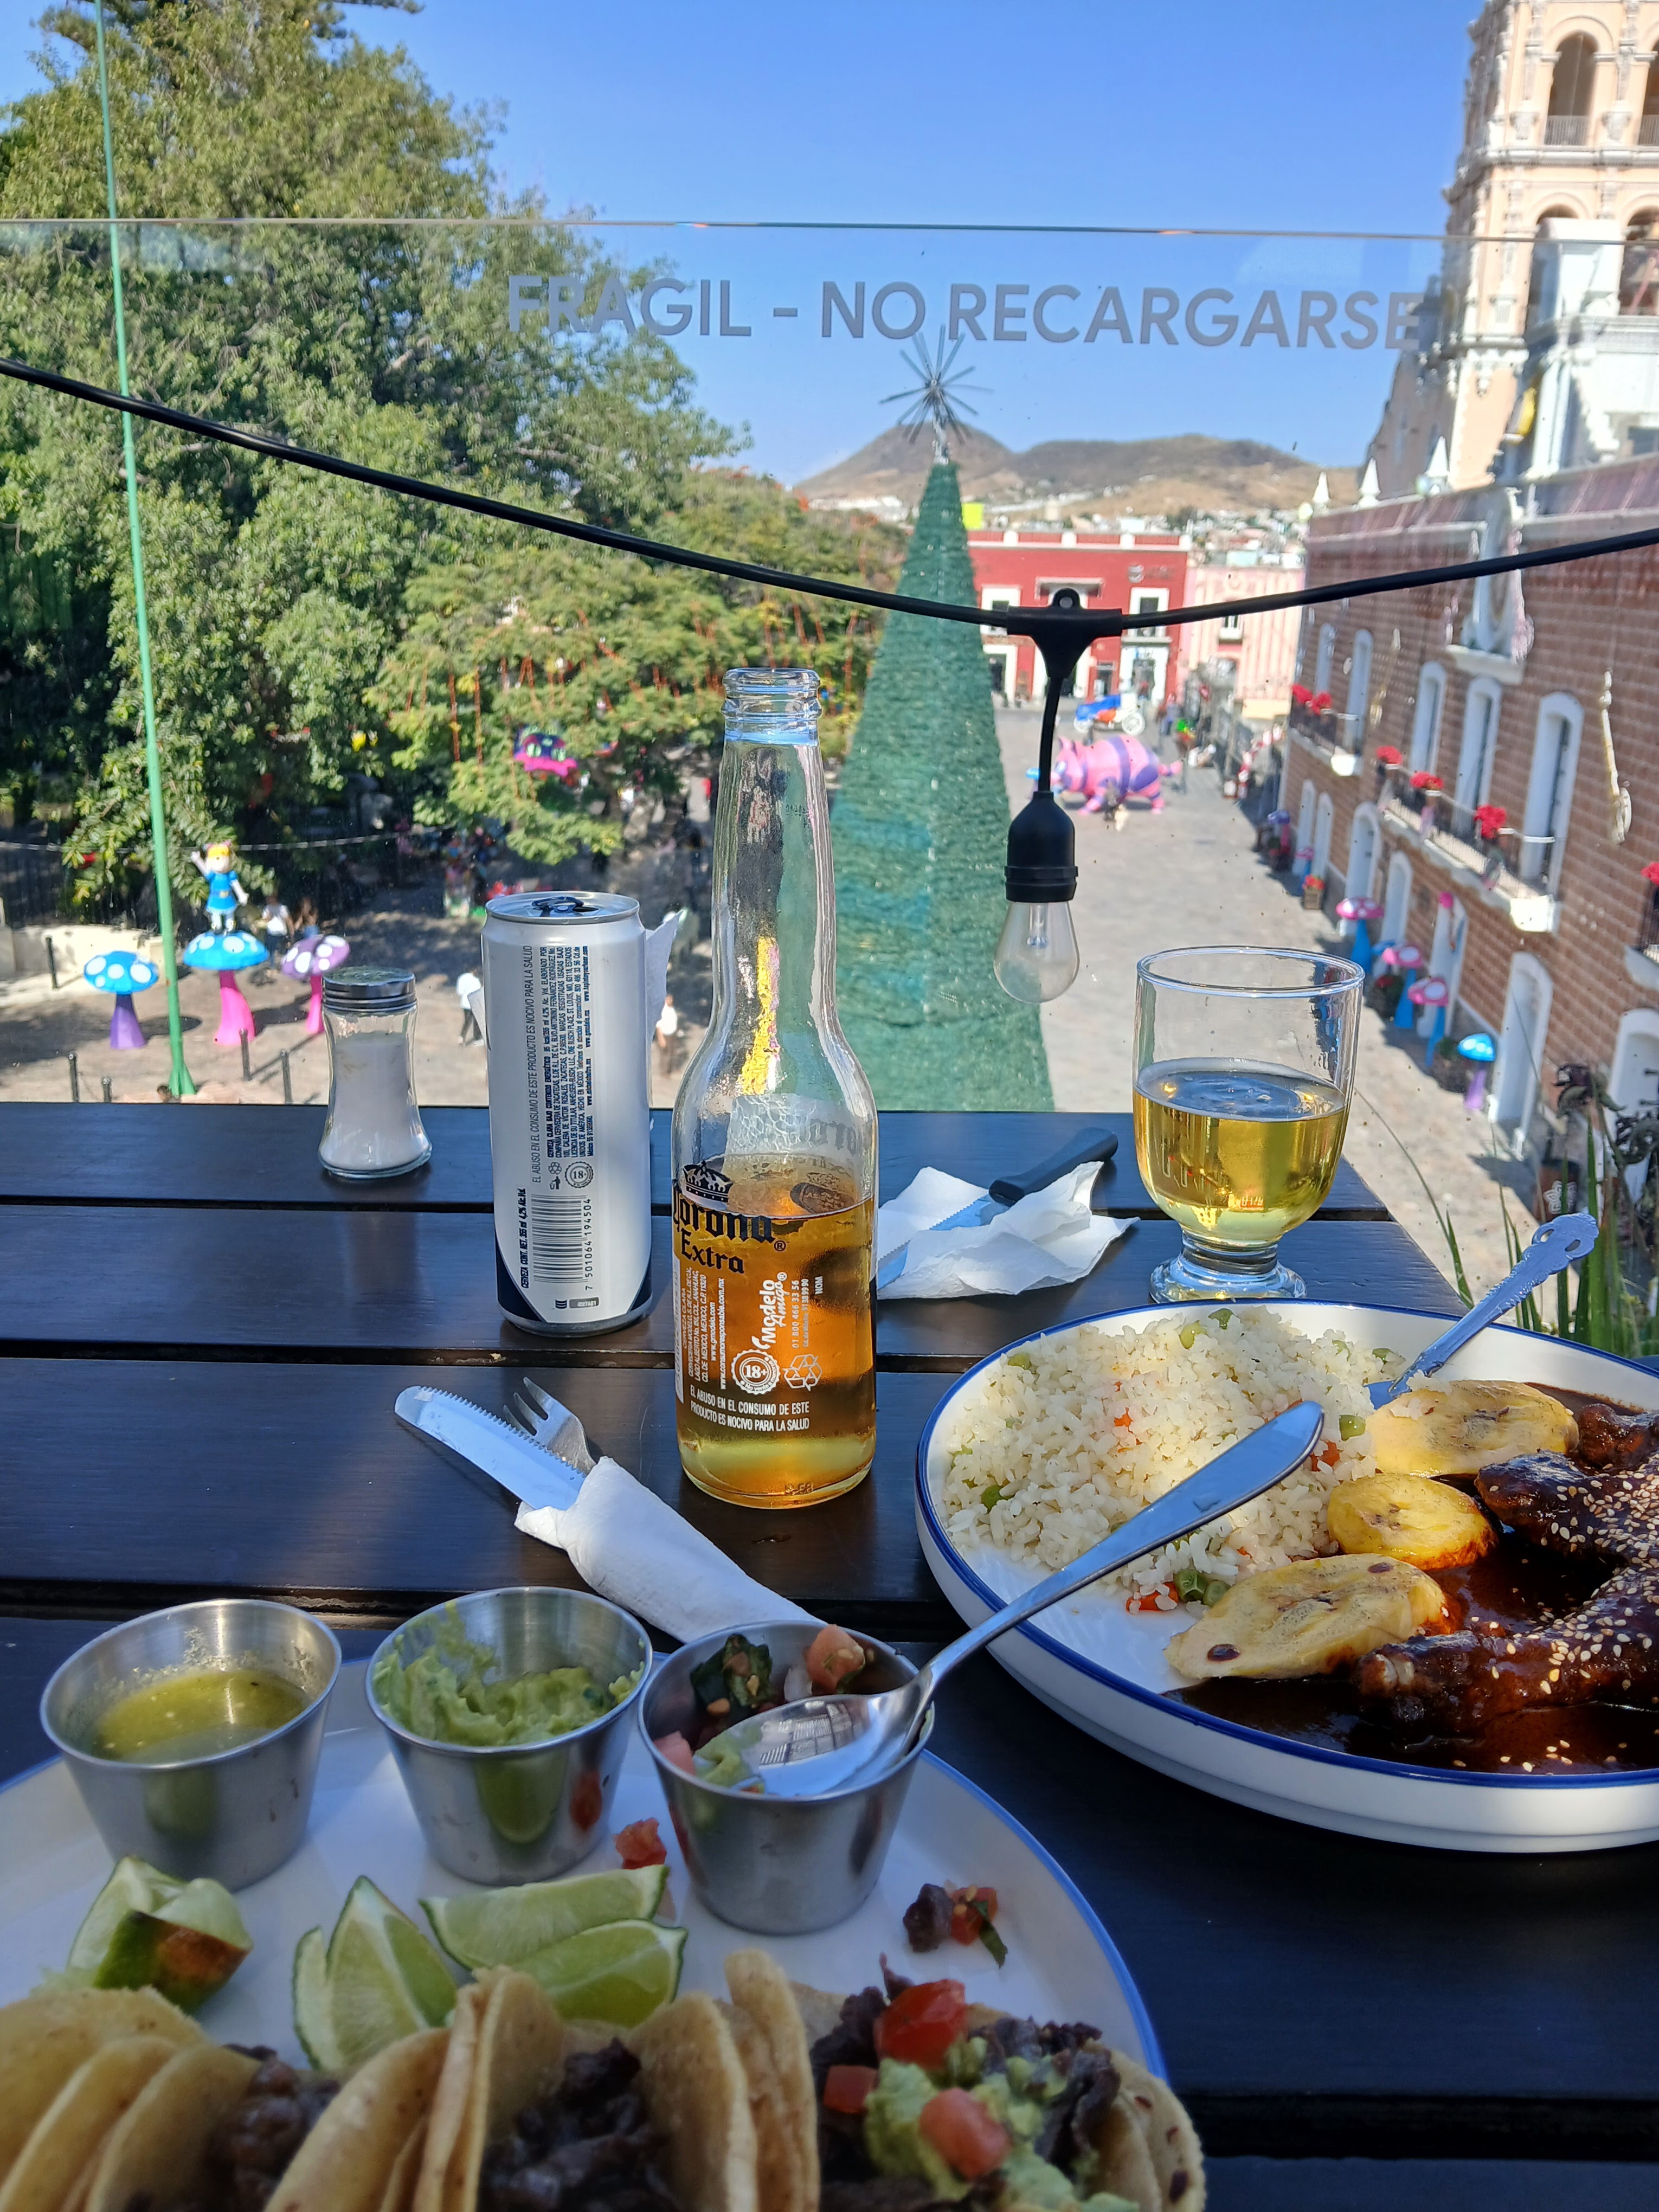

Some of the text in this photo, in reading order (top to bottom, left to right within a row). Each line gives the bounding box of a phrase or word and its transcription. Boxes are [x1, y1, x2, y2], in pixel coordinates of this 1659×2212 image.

[507, 274, 1425, 350] FRAGIL - NO RECARGARSE
[523, 946, 533, 968] SALUD
[524, 969, 533, 978] LA
[524, 979, 533, 997] PARA
[557, 981, 565, 1011] REGISTRADAS
[525, 999, 535, 1024] NOCIVO
[526, 1025, 535, 1033] ES
[526, 1036, 536, 1071] PRODUCTO
[528, 1072, 537, 1088] ESTE
[529, 1089, 538, 1098] DE
[529, 1099, 539, 1131] CONSUMO
[531, 1142, 539, 1151] EN
[531, 1153, 541, 1174] ABUSO
[583, 1199, 591, 1236] 194504
[519, 1239, 528, 1250] NET.
[681, 1227, 744, 1274] Extra
[520, 1251, 528, 1265] CONT.
[584, 1241, 593, 1277] 501064
[520, 1267, 529, 1289] CERVEZA
[792, 1280, 799, 1290] 56
[769, 1281, 789, 1327] Amigo
[792, 1293, 799, 1302] 33
[759, 1279, 776, 1343] Modelo
[709, 1302, 717, 1361] www.gmodelo.com
[792, 1340, 799, 1348] 01
[702, 1360, 708, 1371] DE
[744, 1365, 768, 1379] 18+
[690, 1385, 810, 1416] EL ABUSO EN EL CONSUMO DE ESTE
[691, 1400, 810, 1432] PRODUCTO ES NOCIVO PARA LA SALUD
